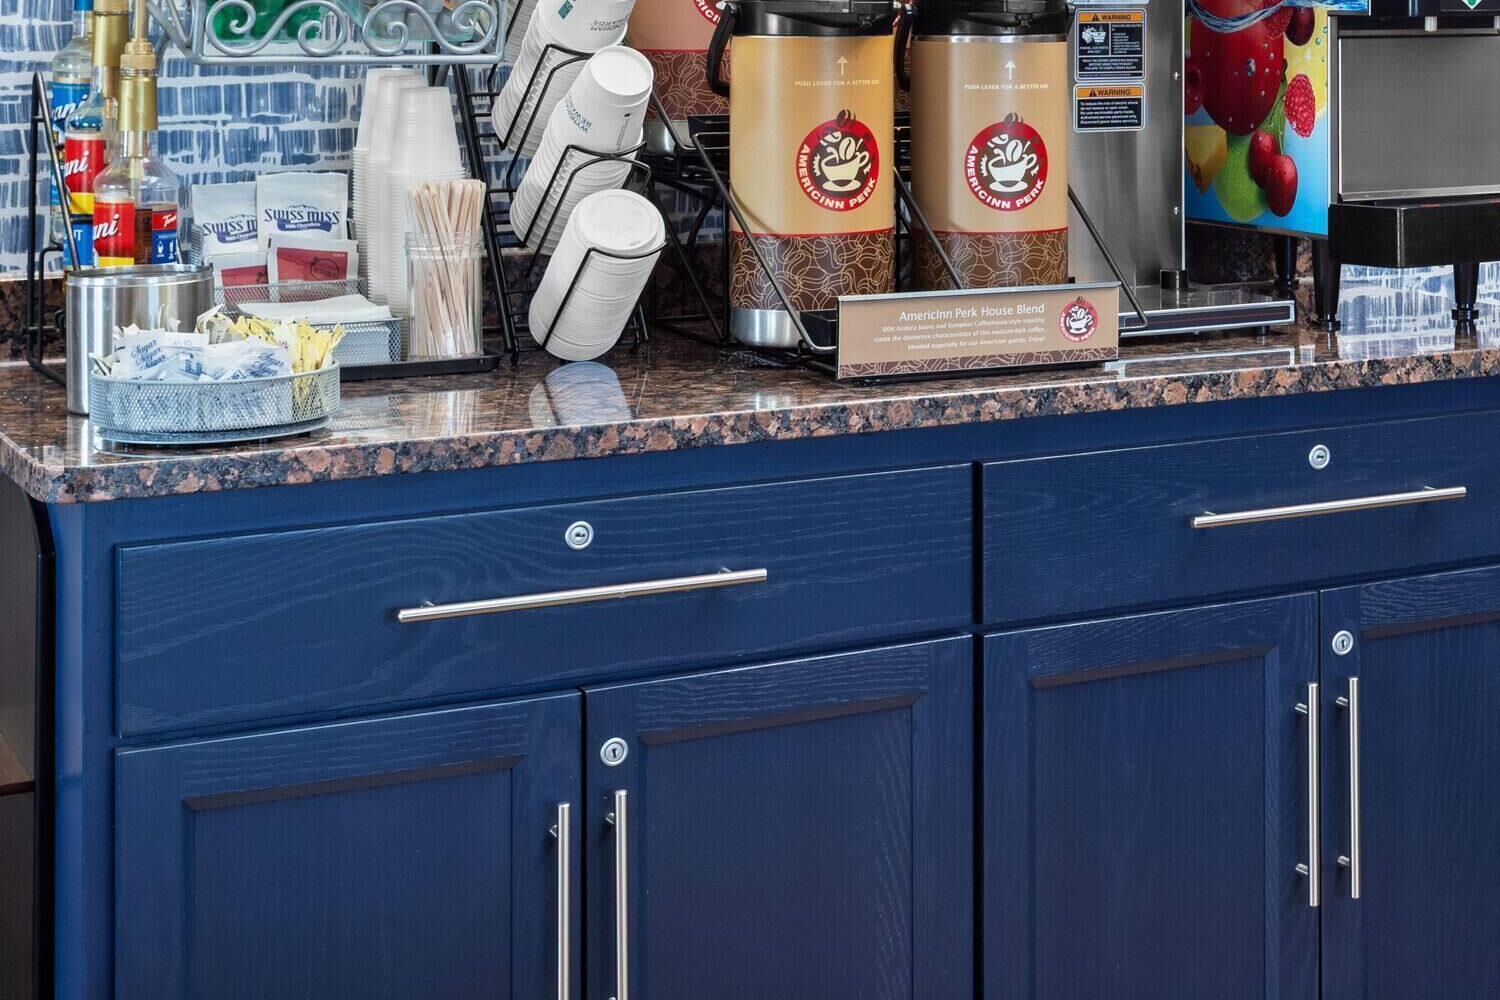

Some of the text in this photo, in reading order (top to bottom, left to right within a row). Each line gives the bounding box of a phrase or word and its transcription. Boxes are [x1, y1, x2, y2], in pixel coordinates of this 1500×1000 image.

[798, 144, 876, 209] AMERICINN PERK
[966, 145, 1044, 209] AMERICINN PERK
[264, 208, 304, 222] SWISS
[203, 220, 244, 236] SWISS
[899, 303, 1045, 321] AmericInn Perk House Blend
[131, 340, 157, 358] Sugar
[931, 341, 958, 349] especially
